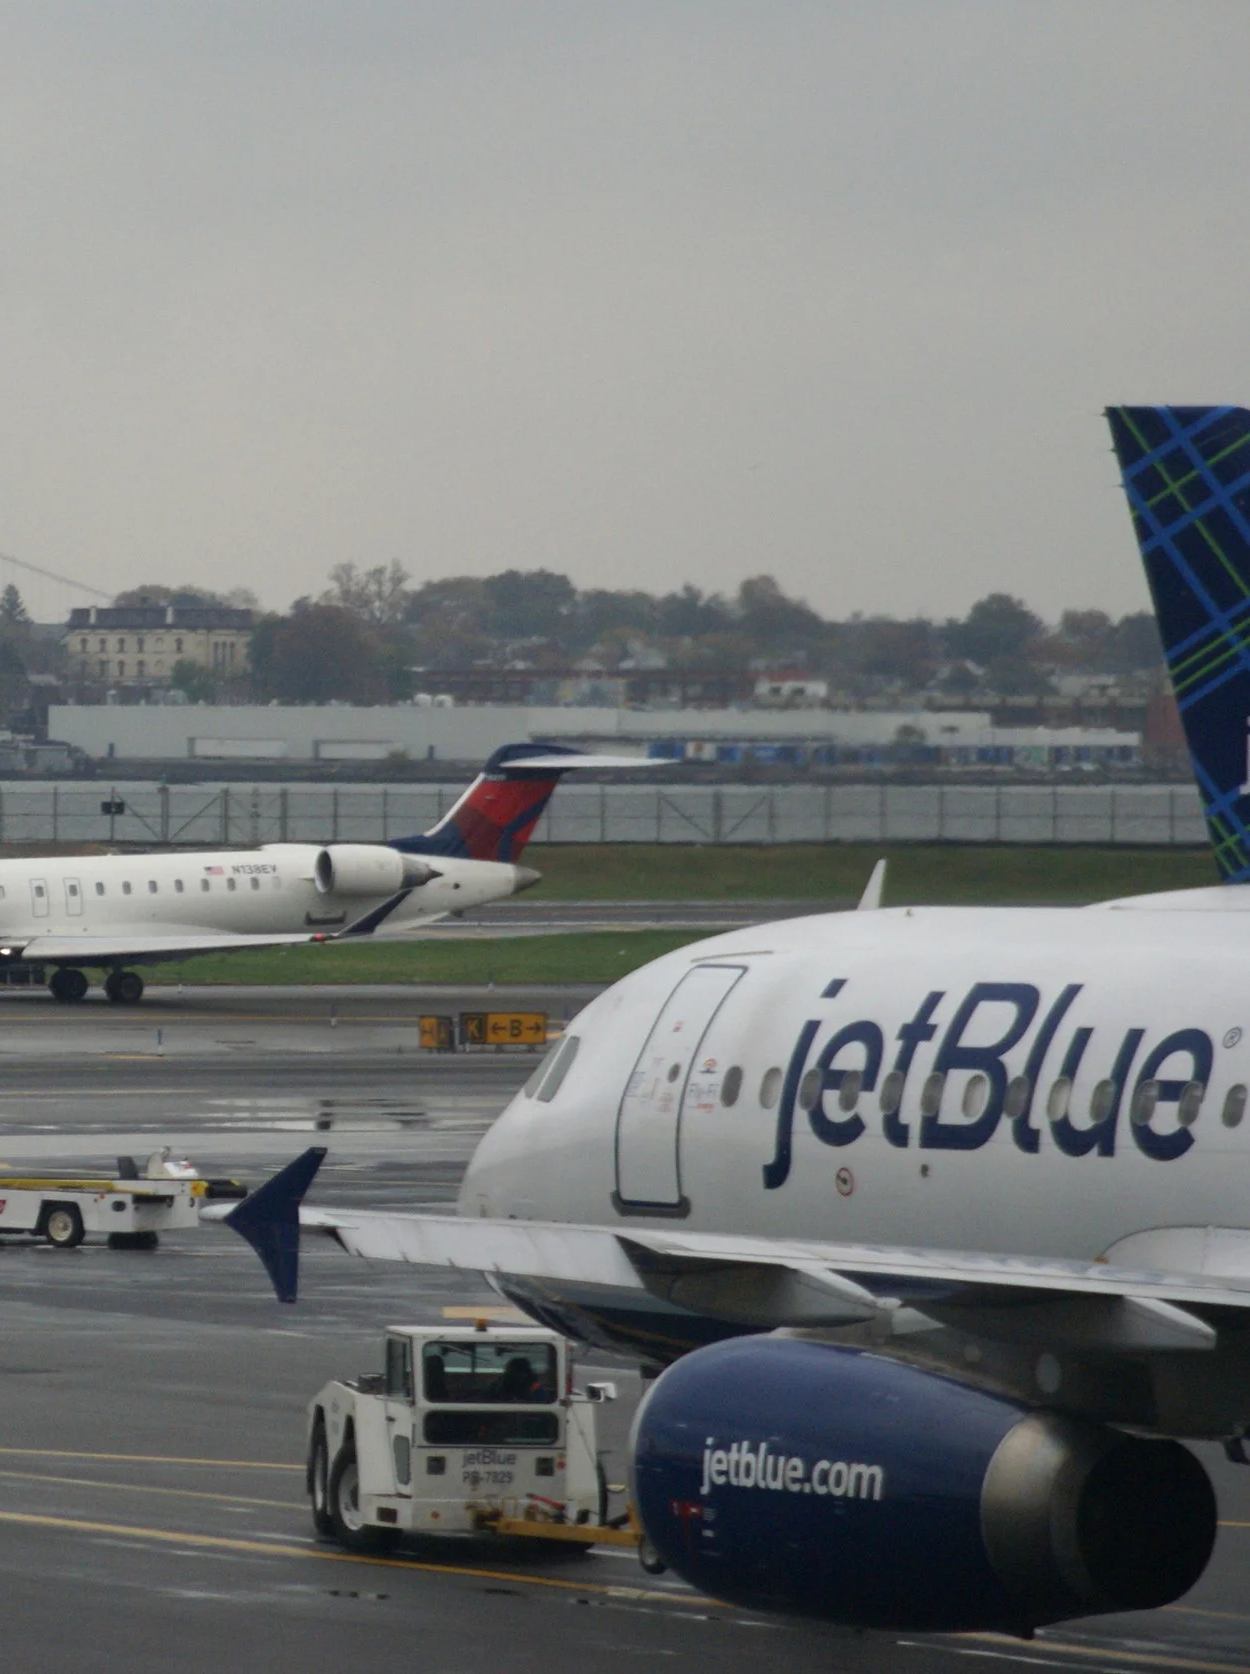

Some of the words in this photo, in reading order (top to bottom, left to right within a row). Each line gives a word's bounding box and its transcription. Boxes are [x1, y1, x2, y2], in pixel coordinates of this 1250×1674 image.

[510, 1019, 524, 1037] B
[762, 978, 1214, 1189] jetBlue
[700, 1436, 884, 1501] jetblue.com
